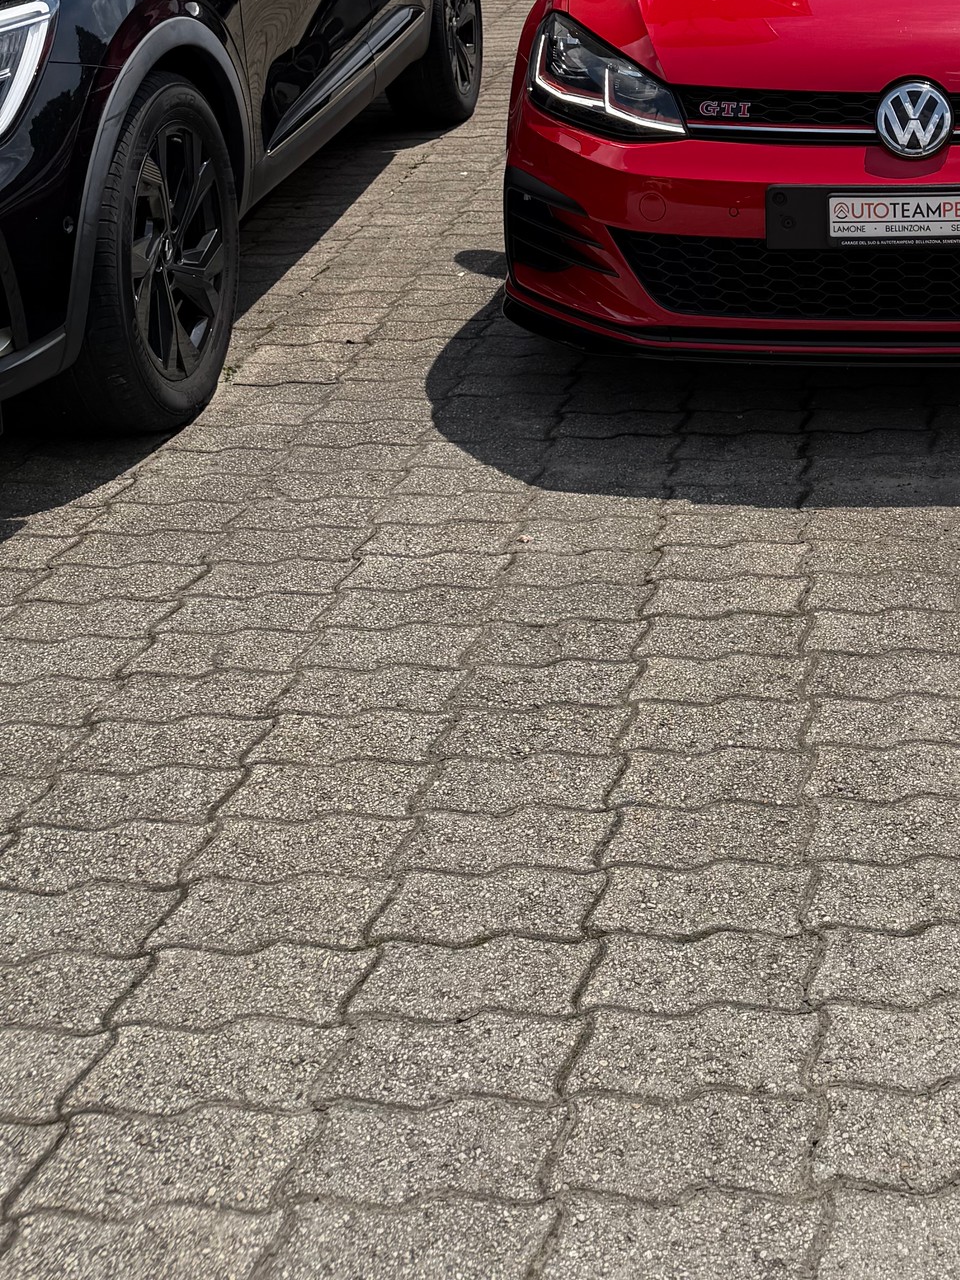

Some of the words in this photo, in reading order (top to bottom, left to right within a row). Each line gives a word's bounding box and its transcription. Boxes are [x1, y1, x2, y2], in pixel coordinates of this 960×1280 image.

[699, 100, 751, 118] GTI
[833, 225, 866, 233] LAMONE
[885, 224, 932, 233] BELLINZONA
